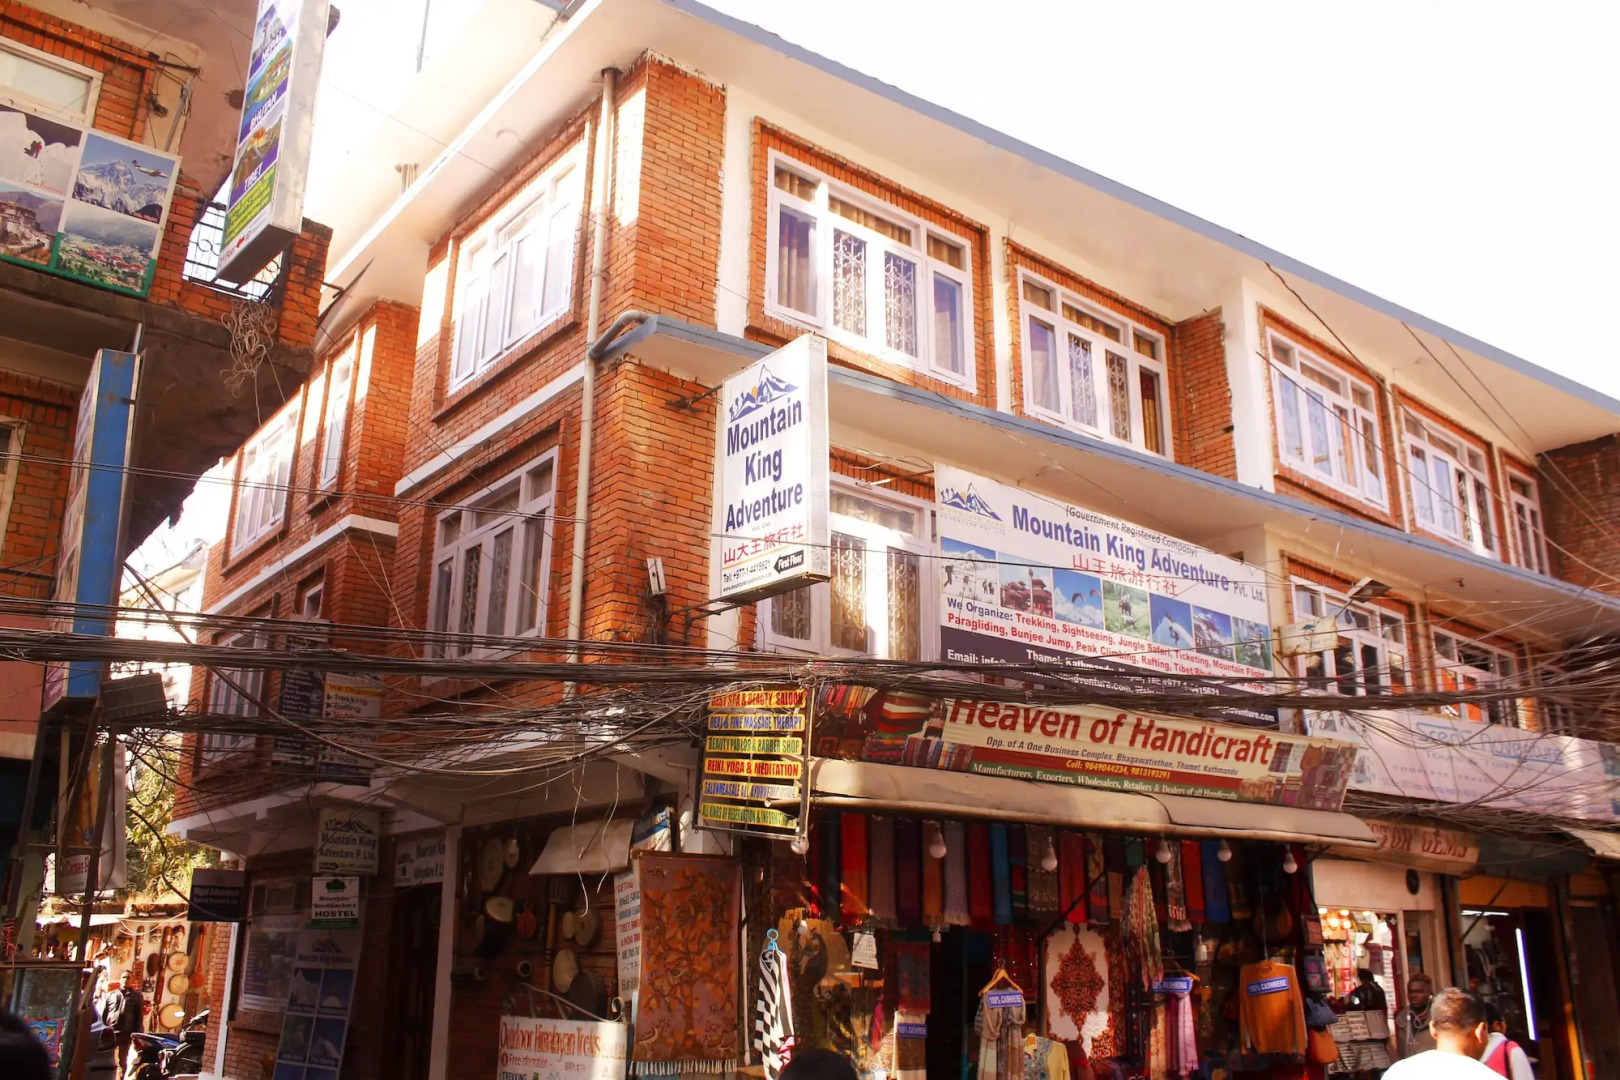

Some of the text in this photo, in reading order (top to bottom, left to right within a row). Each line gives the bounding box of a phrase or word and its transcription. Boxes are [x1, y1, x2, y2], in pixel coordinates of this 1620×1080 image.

[249, 91, 277, 131] BHUTAN
[244, 162, 263, 191] TIBET
[726, 397, 803, 458] Mountain
[745, 447, 783, 486] King
[725, 481, 804, 533] Adventure
[1065, 504, 1198, 559] (Government Registered Company)
[777, 553, 803, 571] First Floor
[1012, 504, 1266, 603] Mountain King Adventure Pvt. Ltd.
[947, 596, 1266, 678] We Organize: Trekking, Sightseeing, Jungle Safari, Ticketing, Mountain Flight
[948, 613, 1009, 637] Paragliding,
[1011, 626, 1044, 643] Bunjee
[1046, 634, 1074, 651] Jump,
[1076, 640, 1098, 654] Peak
[1100, 645, 1139, 665] Climbing,
[1141, 655, 1173, 672] Rafting,
[947, 648, 979, 664] Email:
[334, 693, 368, 706] Trekking
[711, 695, 726, 707] BEST
[741, 693, 747, 706] &
[748, 692, 773, 706] BEAUTY
[776, 690, 804, 706] SALOON
[333, 703, 362, 714] Rafting
[731, 716, 743, 730] FINE
[744, 716, 772, 730] MASSAGE
[773, 716, 803, 730] THERAPY
[949, 699, 1273, 765] Heaven of Handicraft
[708, 737, 731, 750] BEAUTY
[751, 739, 757, 752] &
[758, 739, 781, 753] BARBER
[782, 740, 800, 754] SHOP
[986, 736, 1004, 748] Opp.
[1007, 740, 1017, 750] of
[1018, 741, 1025, 750] A
[1027, 742, 1043, 752] One
[1044, 744, 1079, 757] Business
[1081, 749, 1114, 761] Complex,
[1116, 753, 1175, 769] Bhagawatisthan,
[1203, 764, 1239, 776] Kathmandu
[726, 760, 745, 773] YOGA
[746, 761, 752, 775] &
[754, 761, 800, 777] MEDITATION
[1066, 759, 1083, 770] Cell:
[1084, 763, 1129, 775] 9849044234,
[1393, 764, 1449, 778] COMPETE
[972, 763, 1239, 801] Manufacturers, Exporters, Wholesalers, Retailers & Dealers of all Handicrafts
[320, 831, 377, 850] Mountain King
[318, 847, 355, 860] Adventure
[314, 910, 357, 918] HOSTEL
[1260, 978, 1288, 991] CASHMERE
[500, 1022, 533, 1050] Outdoor
[534, 1023, 575, 1063] Himalayan
[576, 1026, 602, 1058] Treks
